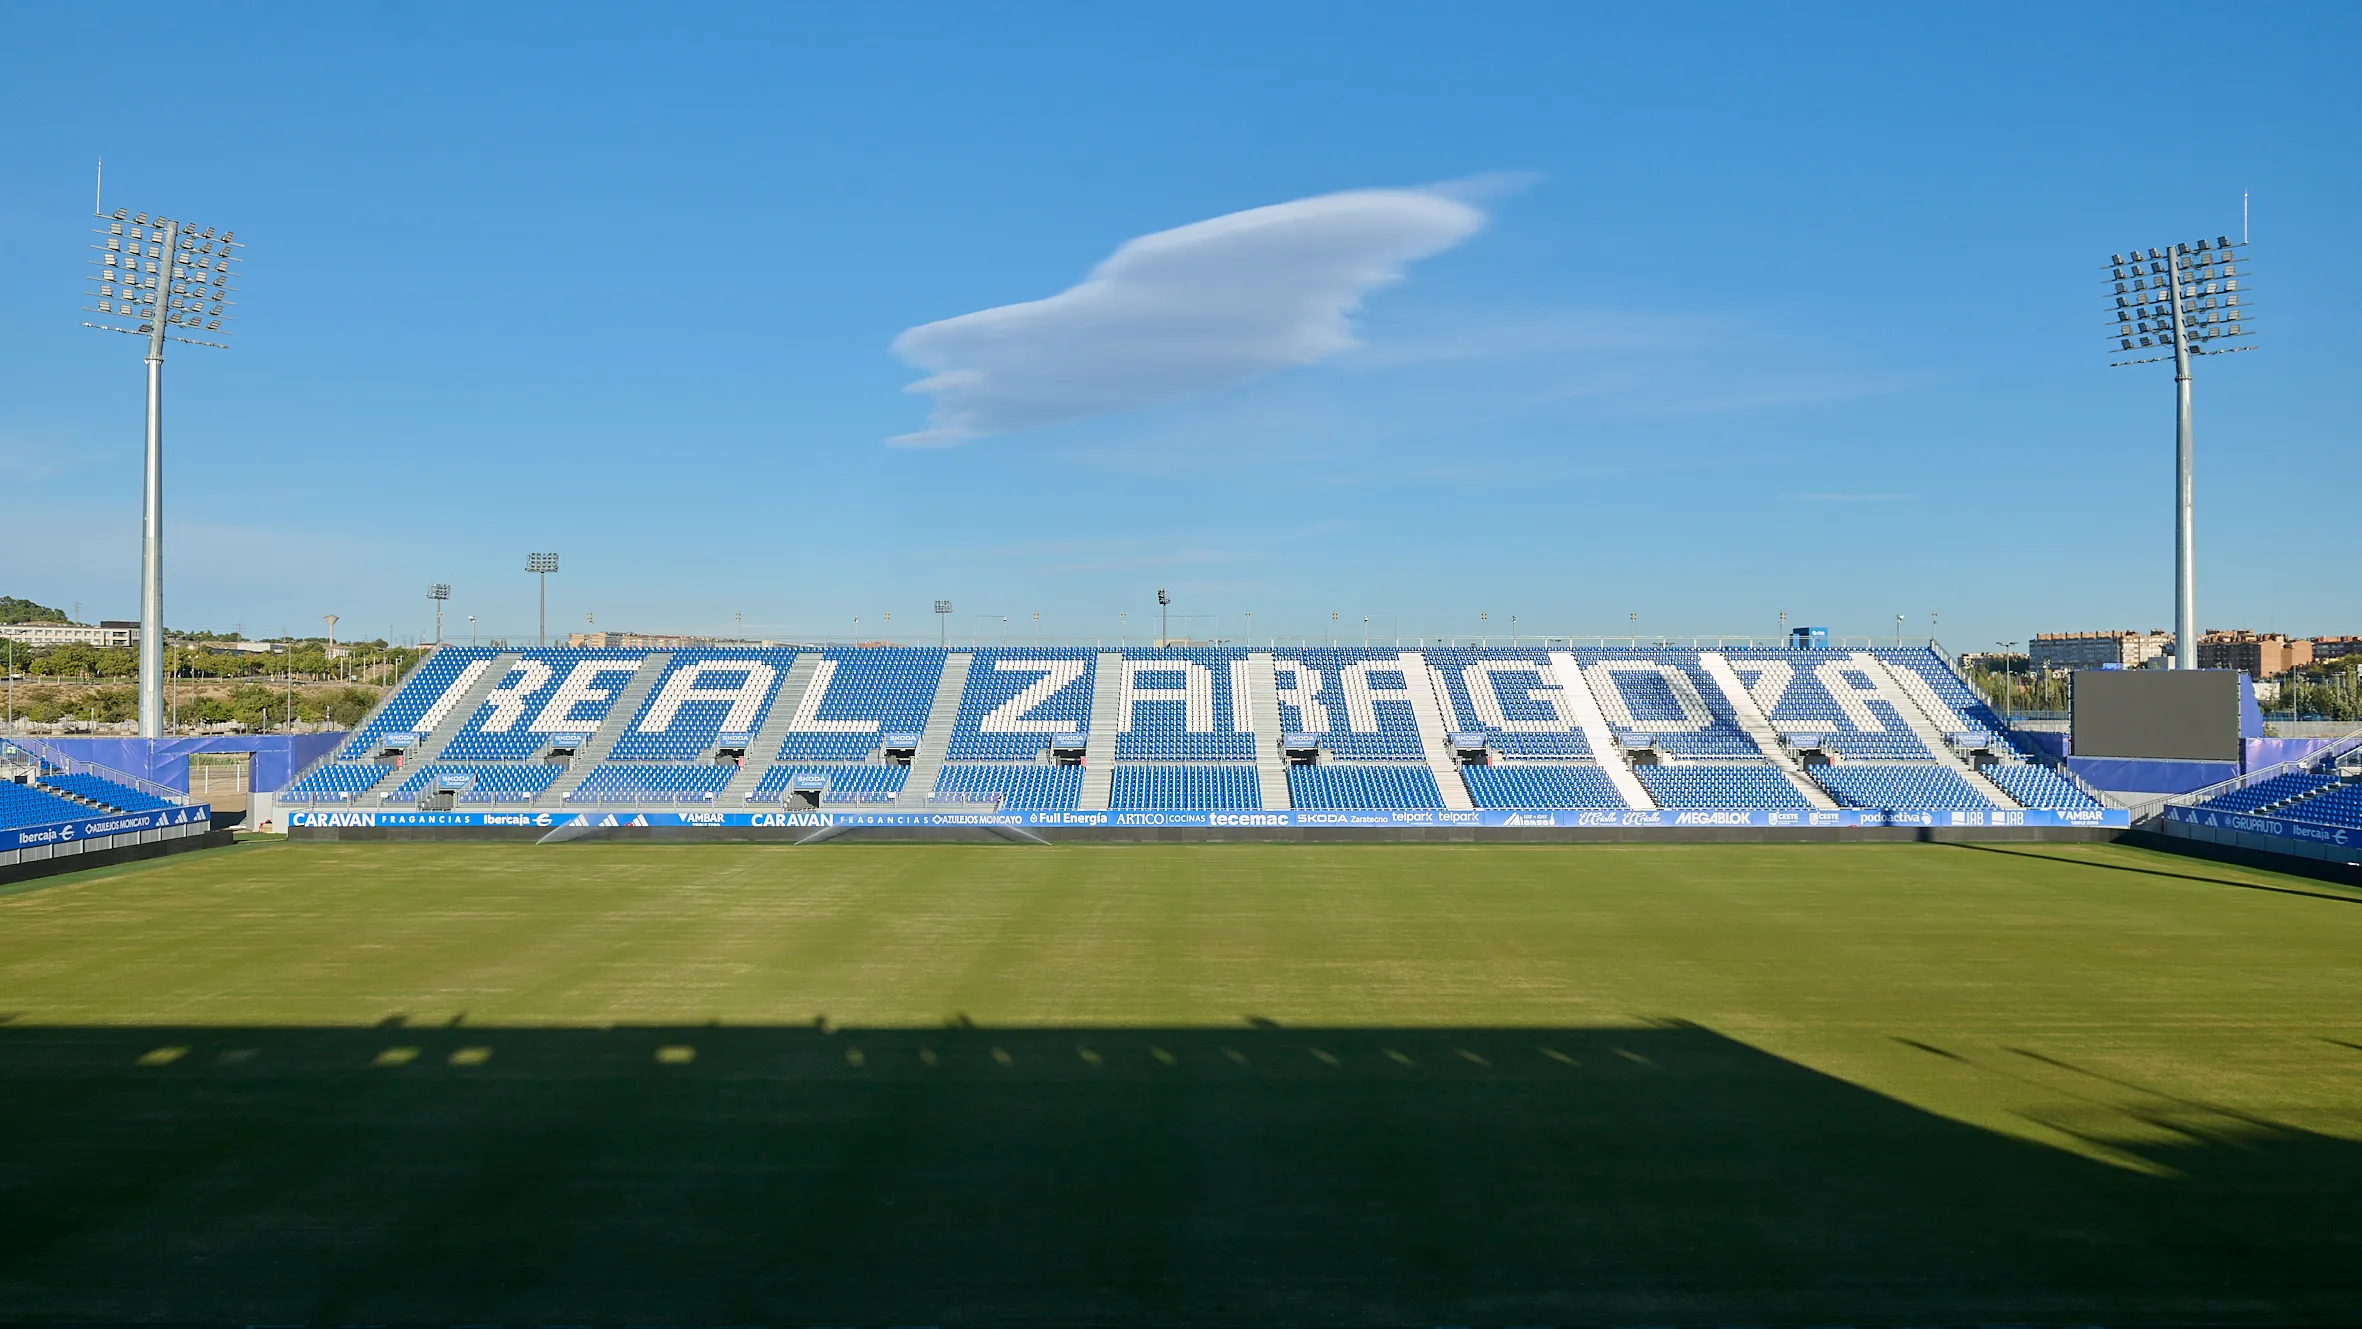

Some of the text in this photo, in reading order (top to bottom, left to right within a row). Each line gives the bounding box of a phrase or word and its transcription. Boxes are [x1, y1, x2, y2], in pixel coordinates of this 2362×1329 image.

[415, 659, 1969, 733] REAL ZARAGOZA
[293, 814, 470, 826] CARAVAN FRAGANCIAS
[484, 814, 530, 826] Ibercaja
[687, 814, 725, 822] AMBAR
[751, 814, 928, 826] CARAVAN FRAGANCIAS
[942, 816, 1022, 824] AZULEJOS MONCAYO
[1040, 812, 1107, 826] Full Energía
[1116, 814, 1164, 824] ARTICO
[1209, 812, 1288, 825] tecemac
[1392, 812, 1433, 823] telpark
[1438, 812, 1479, 823] telpark
[1675, 812, 1750, 824] MEGABLOK
[1860, 812, 1920, 825] podoactiva
[1966, 812, 1984, 825] JAB
[2006, 812, 2024, 825] JAB
[2066, 811, 2104, 820] AMBAR
[93, 817, 150, 833] AZULEJOS MONCAYO
[2233, 816, 2282, 834] GRUPAUTO
[20, 829, 57, 844] Ibercaja
[2293, 825, 2329, 840] Ibercaja
